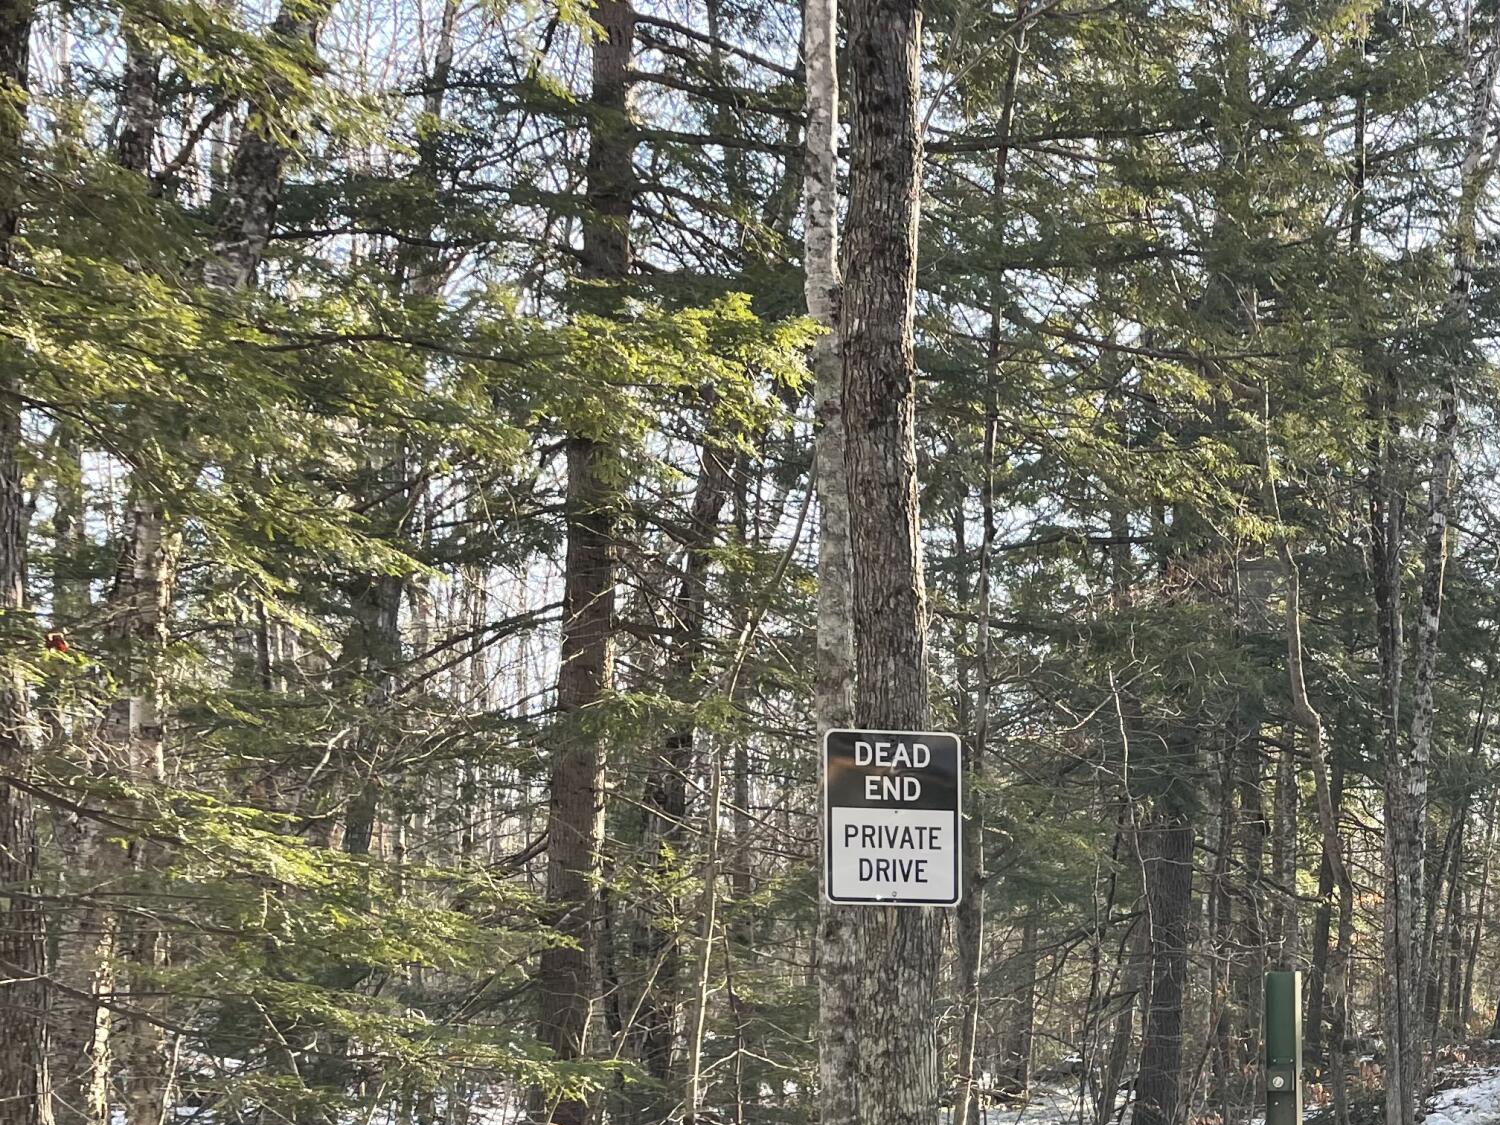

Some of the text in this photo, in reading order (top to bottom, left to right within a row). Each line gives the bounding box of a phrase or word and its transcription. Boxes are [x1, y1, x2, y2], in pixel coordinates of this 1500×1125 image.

[855, 741, 931, 768] DEAD
[865, 775, 921, 801] END
[844, 824, 942, 850] PRIVATE
[859, 858, 928, 883] DRIVE
